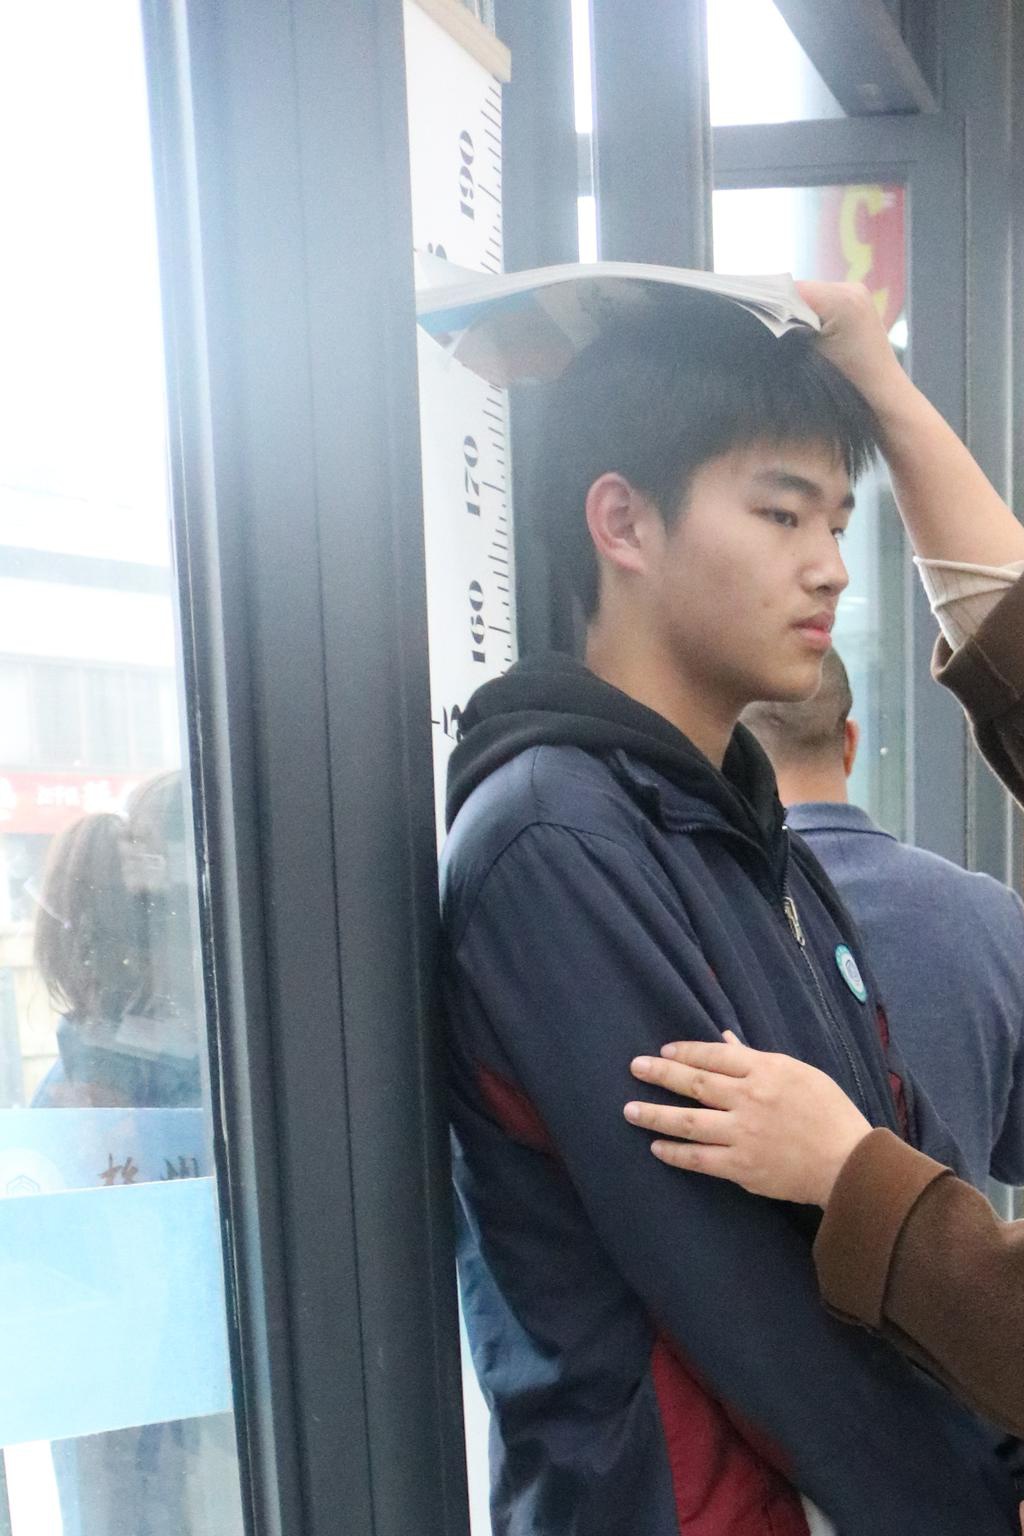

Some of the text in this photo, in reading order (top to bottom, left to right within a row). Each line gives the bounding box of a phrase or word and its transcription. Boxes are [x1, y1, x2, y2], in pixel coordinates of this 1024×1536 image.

[459, 129, 475, 221] 190
[463, 434, 481, 518] 170
[468, 579, 486, 664] 160
